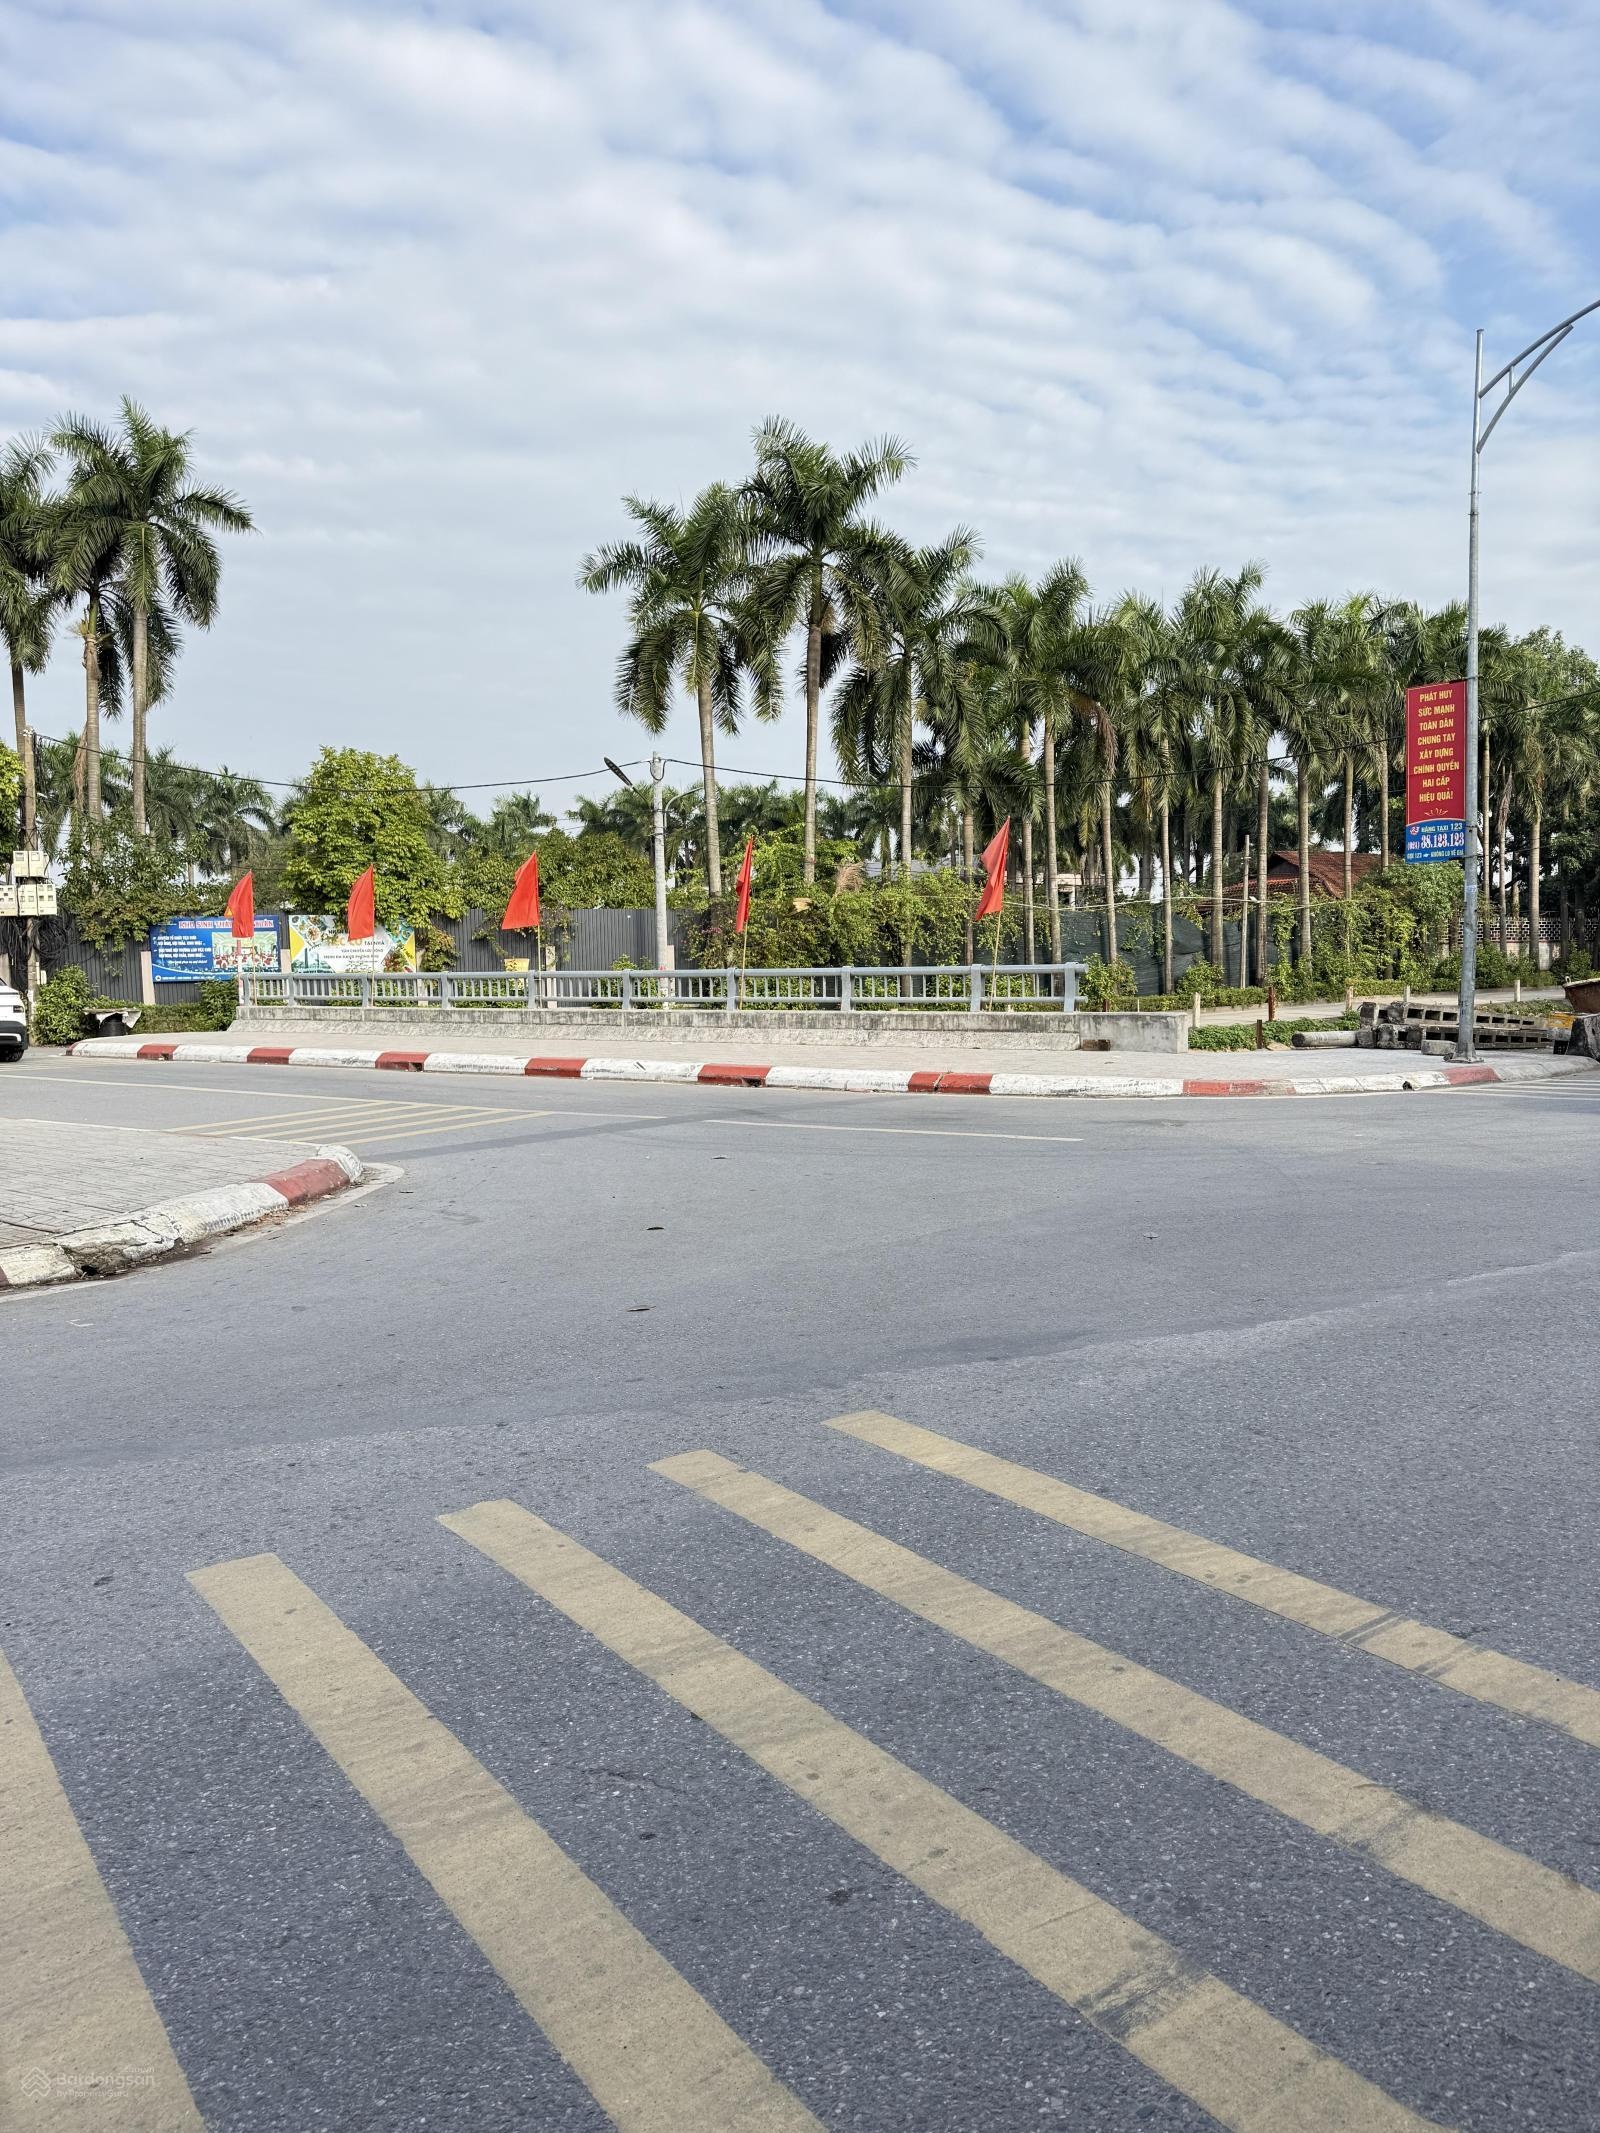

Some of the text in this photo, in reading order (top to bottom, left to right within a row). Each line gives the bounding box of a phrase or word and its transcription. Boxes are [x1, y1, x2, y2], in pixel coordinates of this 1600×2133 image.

[1419, 690, 1453, 703] PHÁT HUY
[1418, 704, 1455, 718] SỨC MẠNH
[1419, 718, 1454, 732] TOÀN DÂN
[1417, 732, 1456, 746] CHUNG TAY
[1420, 748, 1454, 760] XÂY DỰNG
[1413, 763, 1434, 775] CHÍNH
[1422, 775, 1450, 788] HAI CẤP
[1419, 788, 1454, 804] HIỆU QUẢ!
[1421, 832, 1464, 848] 38.123.123
